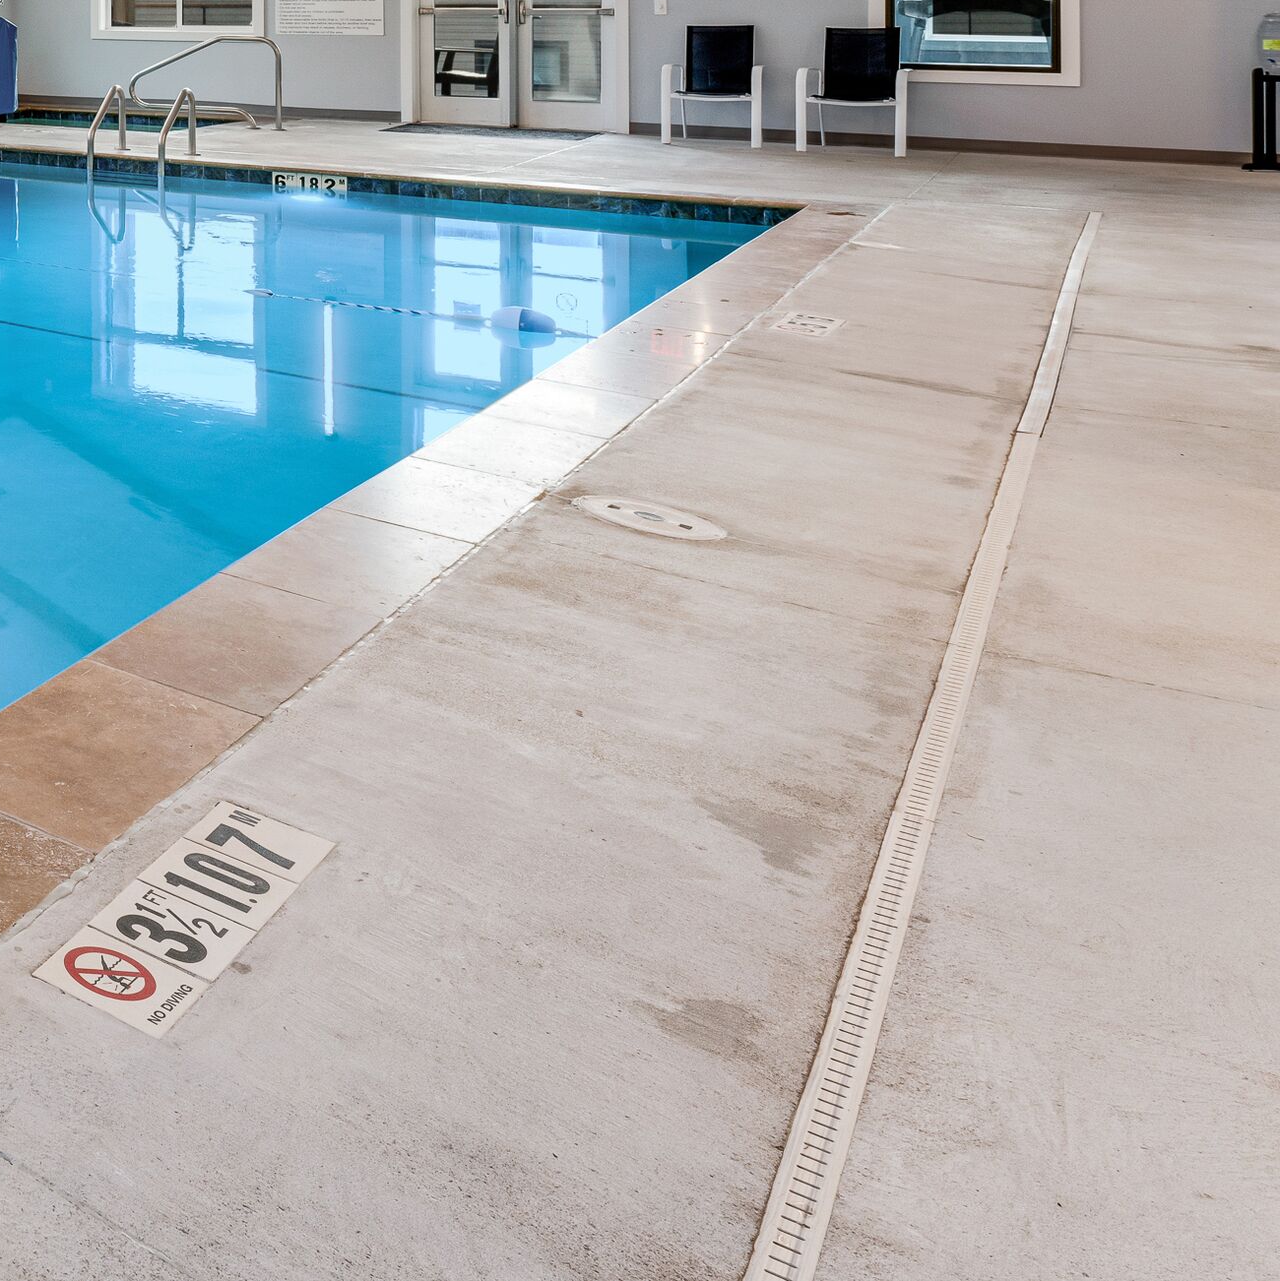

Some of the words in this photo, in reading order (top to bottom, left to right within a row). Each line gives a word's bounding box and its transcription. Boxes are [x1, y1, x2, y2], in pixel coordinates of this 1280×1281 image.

[142, 889, 168, 906] FT
[228, 809, 261, 827] M
[147, 1010, 167, 1025] NO
[162, 983, 194, 1013] DIVING
